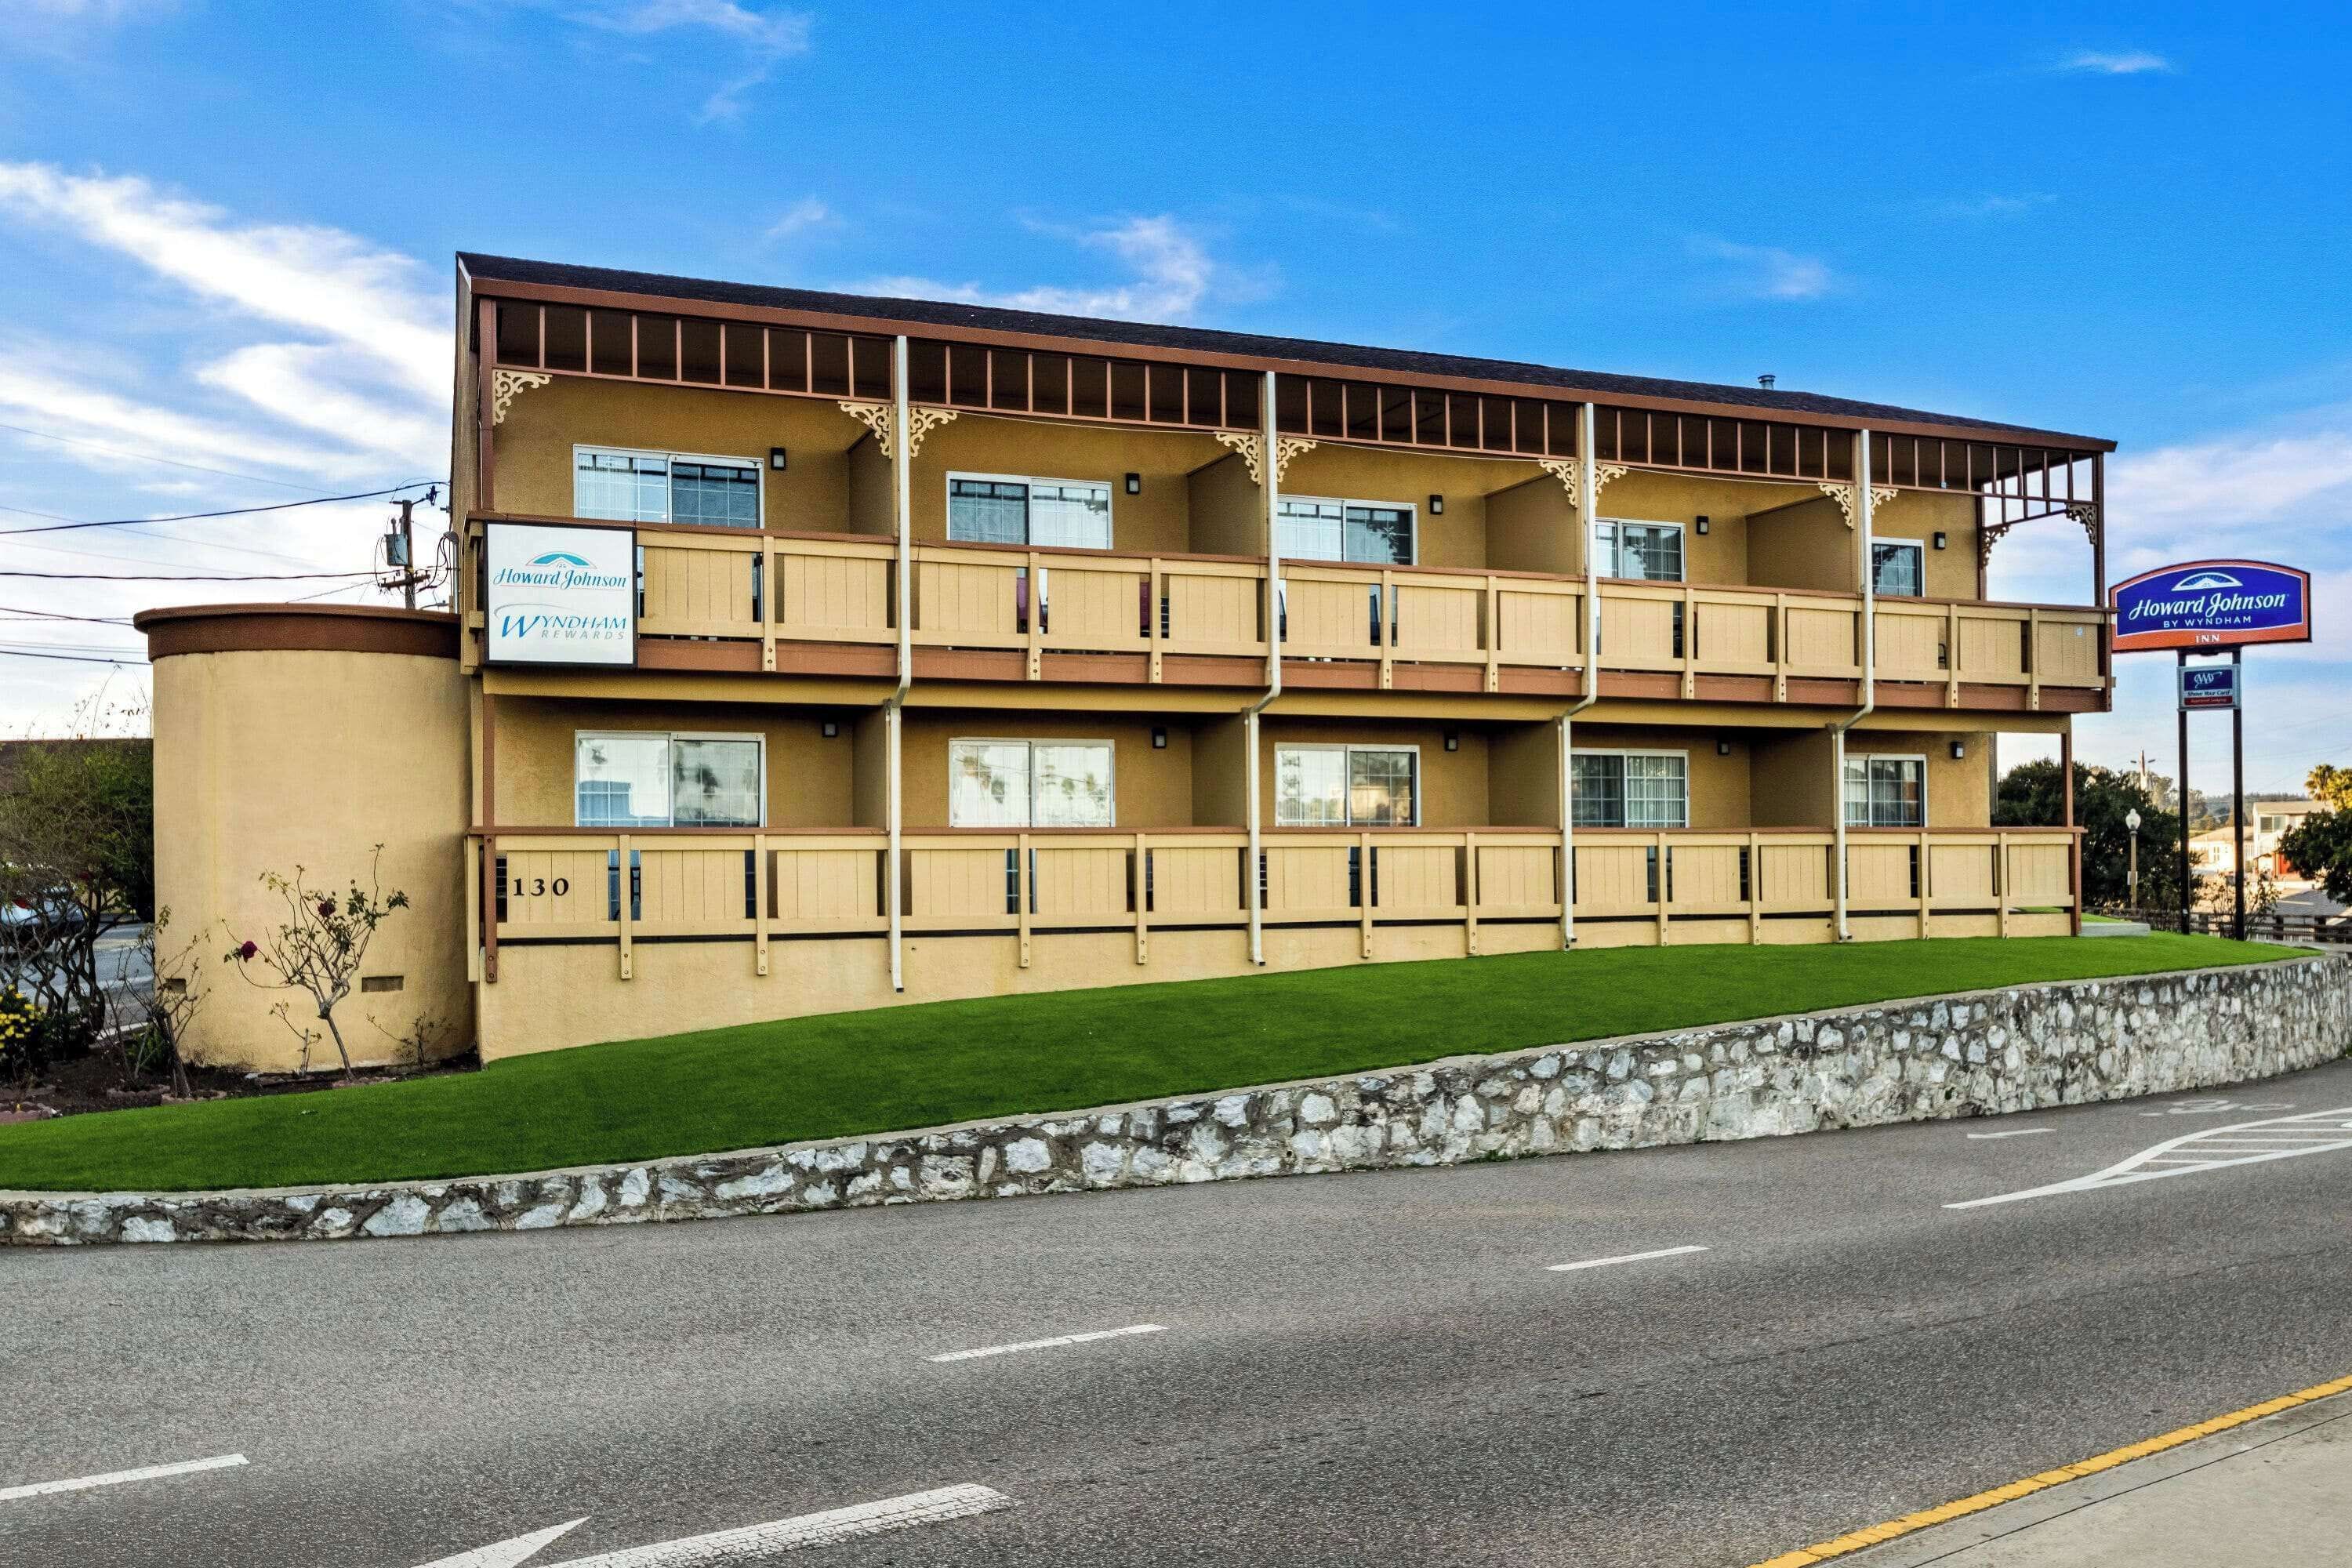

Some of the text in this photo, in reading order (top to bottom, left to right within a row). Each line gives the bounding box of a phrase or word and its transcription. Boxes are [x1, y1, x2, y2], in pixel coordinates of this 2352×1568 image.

[494, 568, 626, 590] Howard Johnson
[2129, 593, 2285, 620] Howard Johnson
[502, 615, 626, 638] WYNDHAM
[2185, 615, 2252, 626] WYNDHAM
[541, 630, 625, 640] REWARDS
[514, 878, 569, 896] 130
